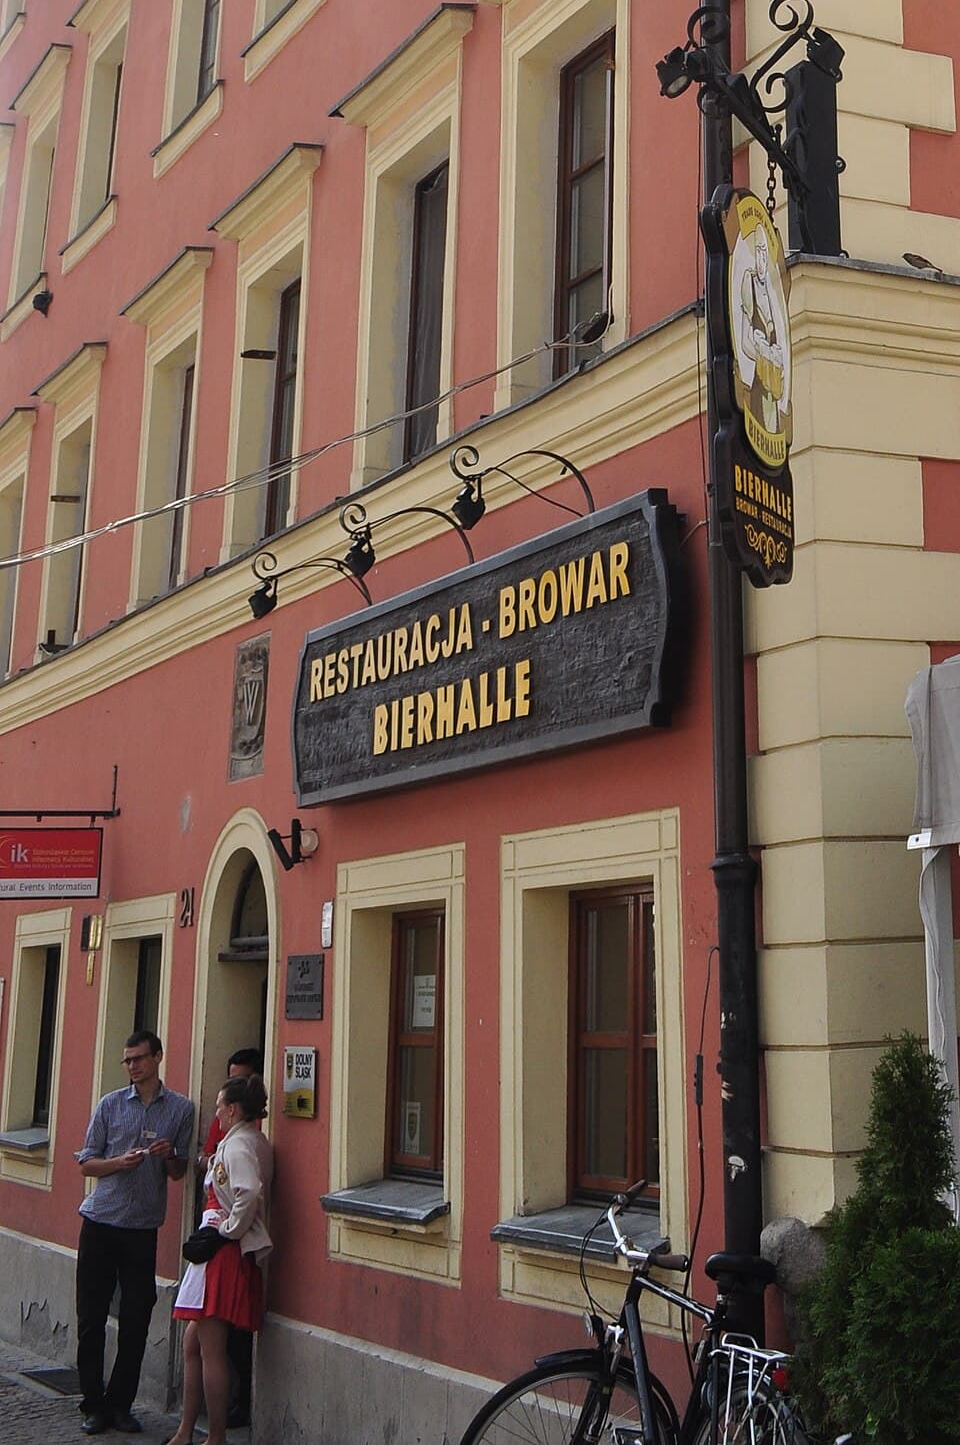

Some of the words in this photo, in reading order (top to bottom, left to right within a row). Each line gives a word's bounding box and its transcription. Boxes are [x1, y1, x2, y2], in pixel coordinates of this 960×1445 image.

[749, 419, 785, 459] BIERHALLE
[735, 465, 792, 521] BIERHALLE
[310, 602, 473, 702] RESTAURACJA
[498, 541, 631, 639] BROWAR
[372, 658, 532, 755] BIERHALLE
[0, 882, 16, 891] ural
[20, 882, 45, 891] Events
[48, 882, 92, 891] Information
[295, 1053, 313, 1065] DOLNY
